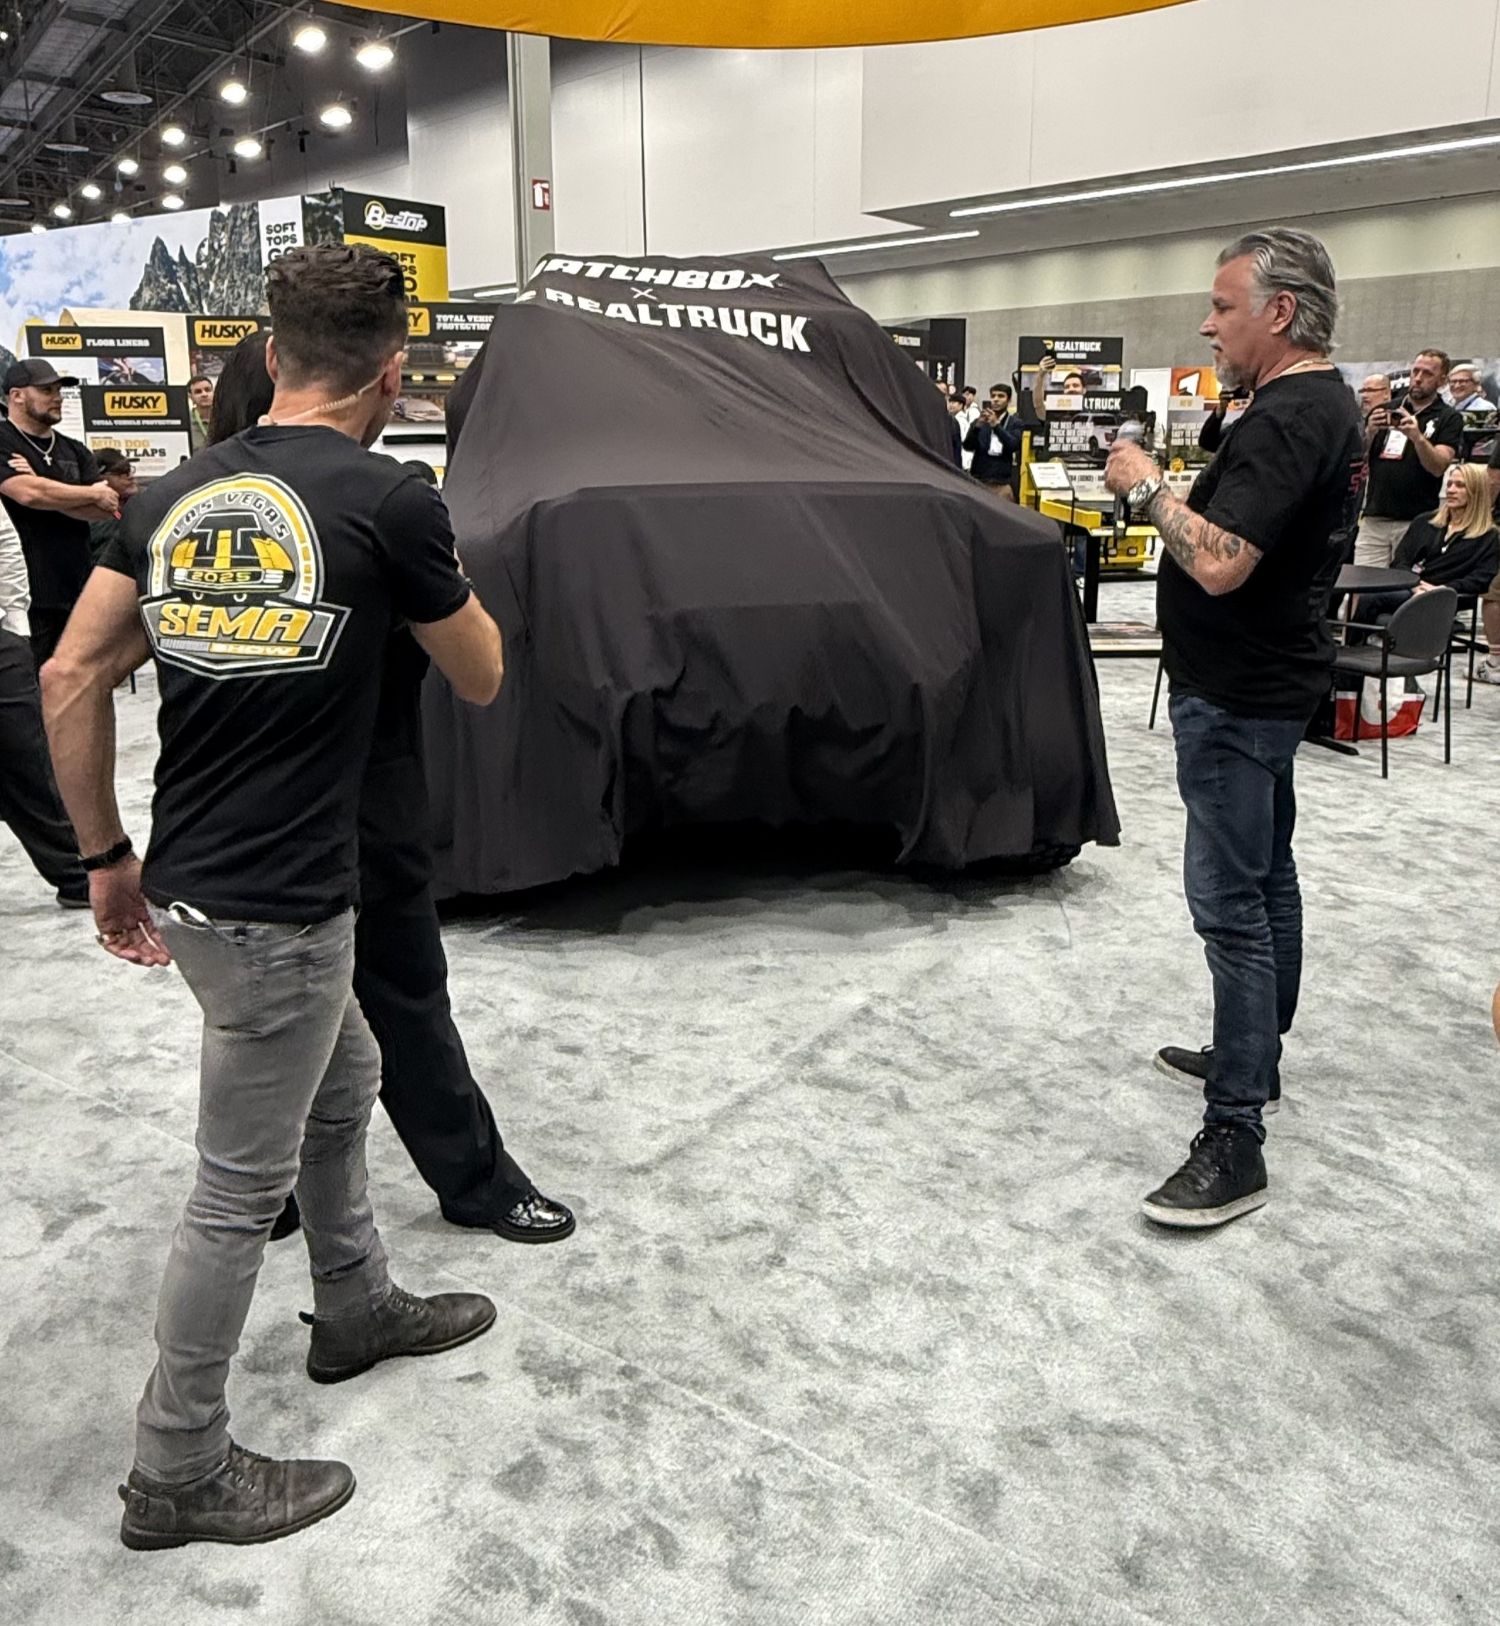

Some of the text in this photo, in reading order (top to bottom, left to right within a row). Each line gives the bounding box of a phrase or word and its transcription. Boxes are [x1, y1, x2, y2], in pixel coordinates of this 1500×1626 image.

[266, 222, 296, 235] SOFT
[266, 234, 298, 246] TOPS
[436, 314, 495, 323] TOTAL VEHIC
[545, 288, 812, 352] REALTRUCK
[201, 324, 252, 338] HUSKY
[46, 336, 150, 347] HUSKY FLOOR LINERS
[1054, 341, 1102, 352] REALTRUCK
[110, 396, 162, 409] HUSKY
[1084, 397, 1122, 410] LTRUCK
[91, 439, 150, 448] MUD DOG
[126, 448, 167, 457] FLAPS
[172, 492, 293, 540] LAS VEGAS
[191, 571, 252, 583] 2025
[158, 602, 314, 643] SEMA
[215, 643, 293, 655] SHOW
